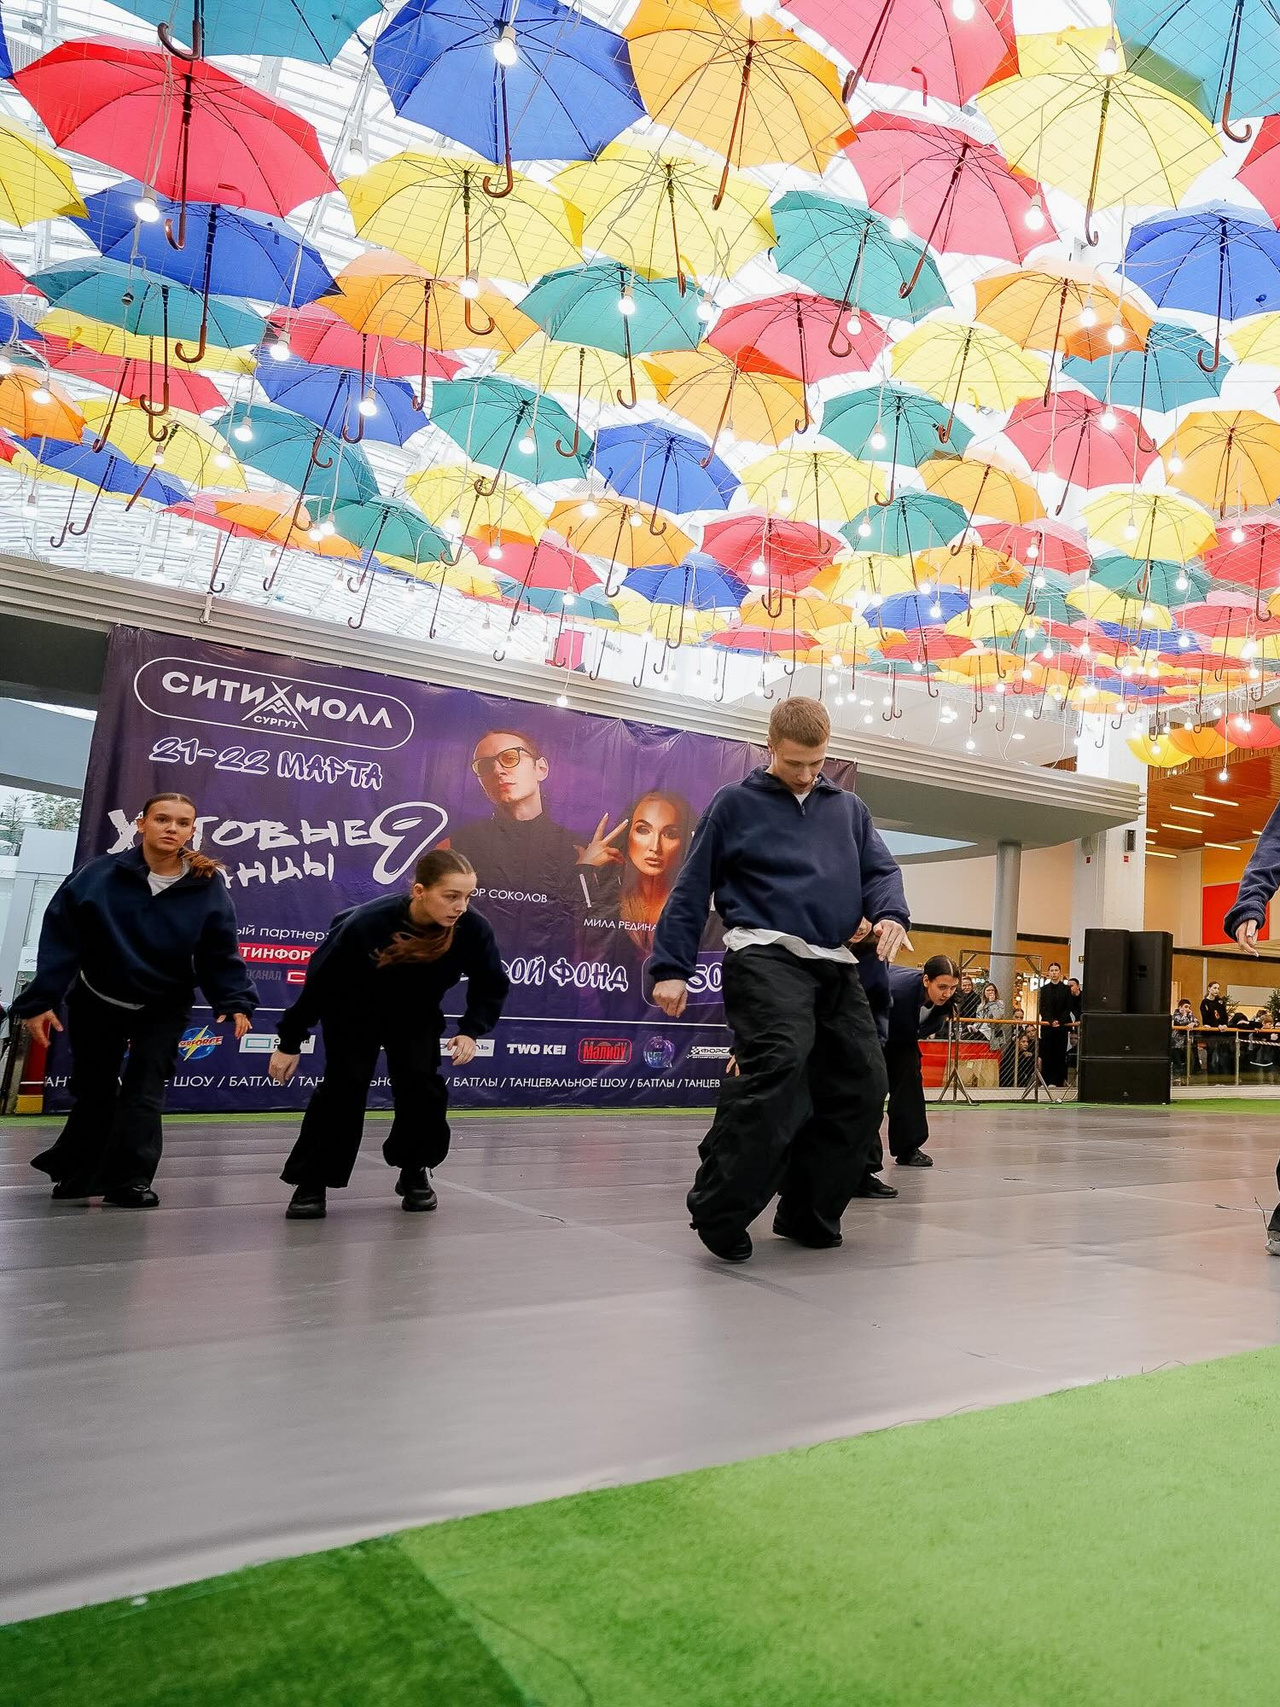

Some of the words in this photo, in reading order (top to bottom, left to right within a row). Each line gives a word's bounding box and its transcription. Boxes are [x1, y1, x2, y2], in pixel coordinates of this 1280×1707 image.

[162, 671, 264, 705] СИТИ
[295, 691, 393, 729] МОЛЛ
[253, 715, 298, 730] СУРГУТ
[149, 736, 271, 775] 21-22
[277, 750, 383, 790] МАРТА
[107, 809, 374, 854] ХТОВЫЕ
[489, 889, 548, 903] СОКОЛОВ
[583, 918, 616, 929] МИЛА
[238, 946, 315, 962] ТИНФОР
[549, 956, 629, 992] ФОНД
[506, 1043, 540, 1055] TWO
[543, 1044, 567, 1055] KEI
[173, 1076, 214, 1087] ШОУ
[453, 1077, 498, 1087] БАТТЛЫ
[509, 1078, 597, 1089] ТАНЦЕВАЛЬНОЕ
[600, 1078, 627, 1088] ШОУ
[637, 1078, 675, 1088] БАТТЛЫ
